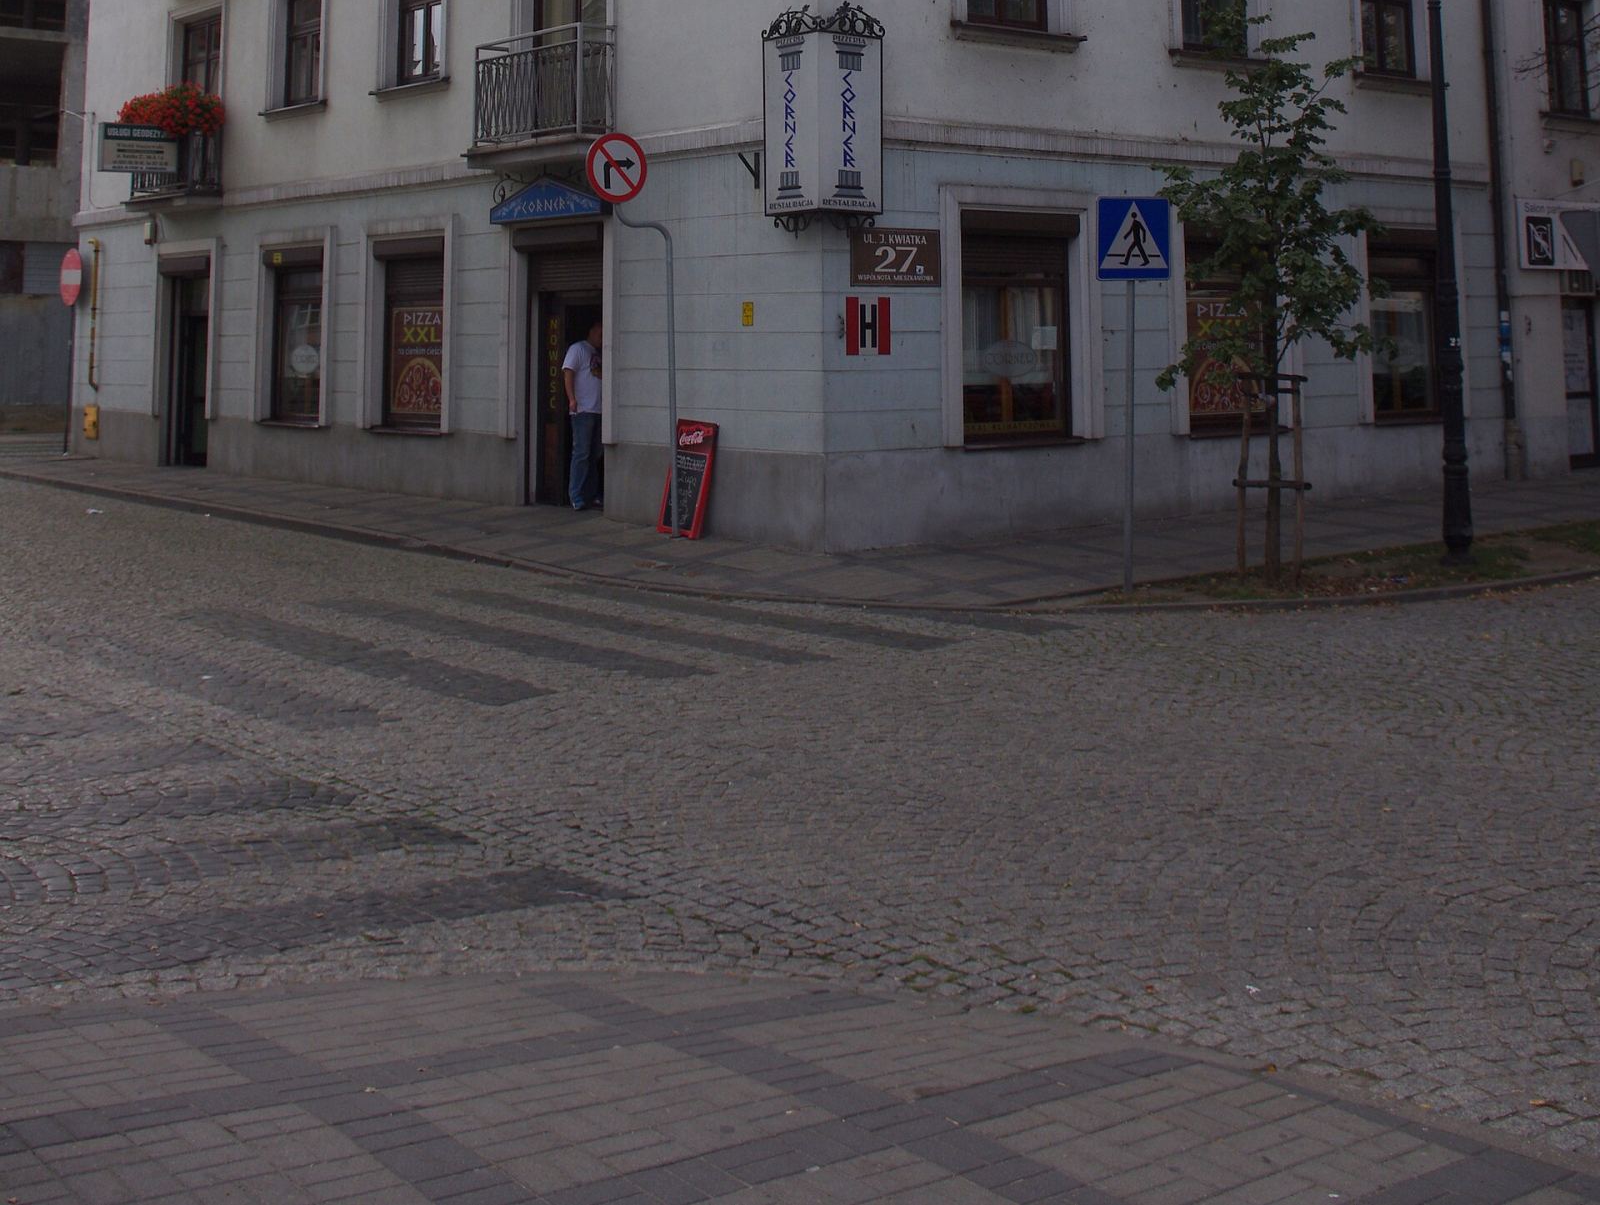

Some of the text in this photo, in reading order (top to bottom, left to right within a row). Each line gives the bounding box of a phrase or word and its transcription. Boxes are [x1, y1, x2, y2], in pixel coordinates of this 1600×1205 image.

[775, 36, 805, 46] PIZZERIA
[832, 35, 866, 45] PIZZERIA
[783, 71, 796, 168] CORNER
[841, 71, 856, 168] CORNER
[522, 196, 566, 213] CORNER
[769, 199, 814, 210] RESTAURACJA
[822, 198, 877, 209] RESTAURACJA
[888, 234, 927, 245] KWIATKA
[874, 245, 918, 273] 27
[403, 312, 442, 325] PIZZA
[860, 304, 877, 348] H
[403, 326, 441, 343] XXL
